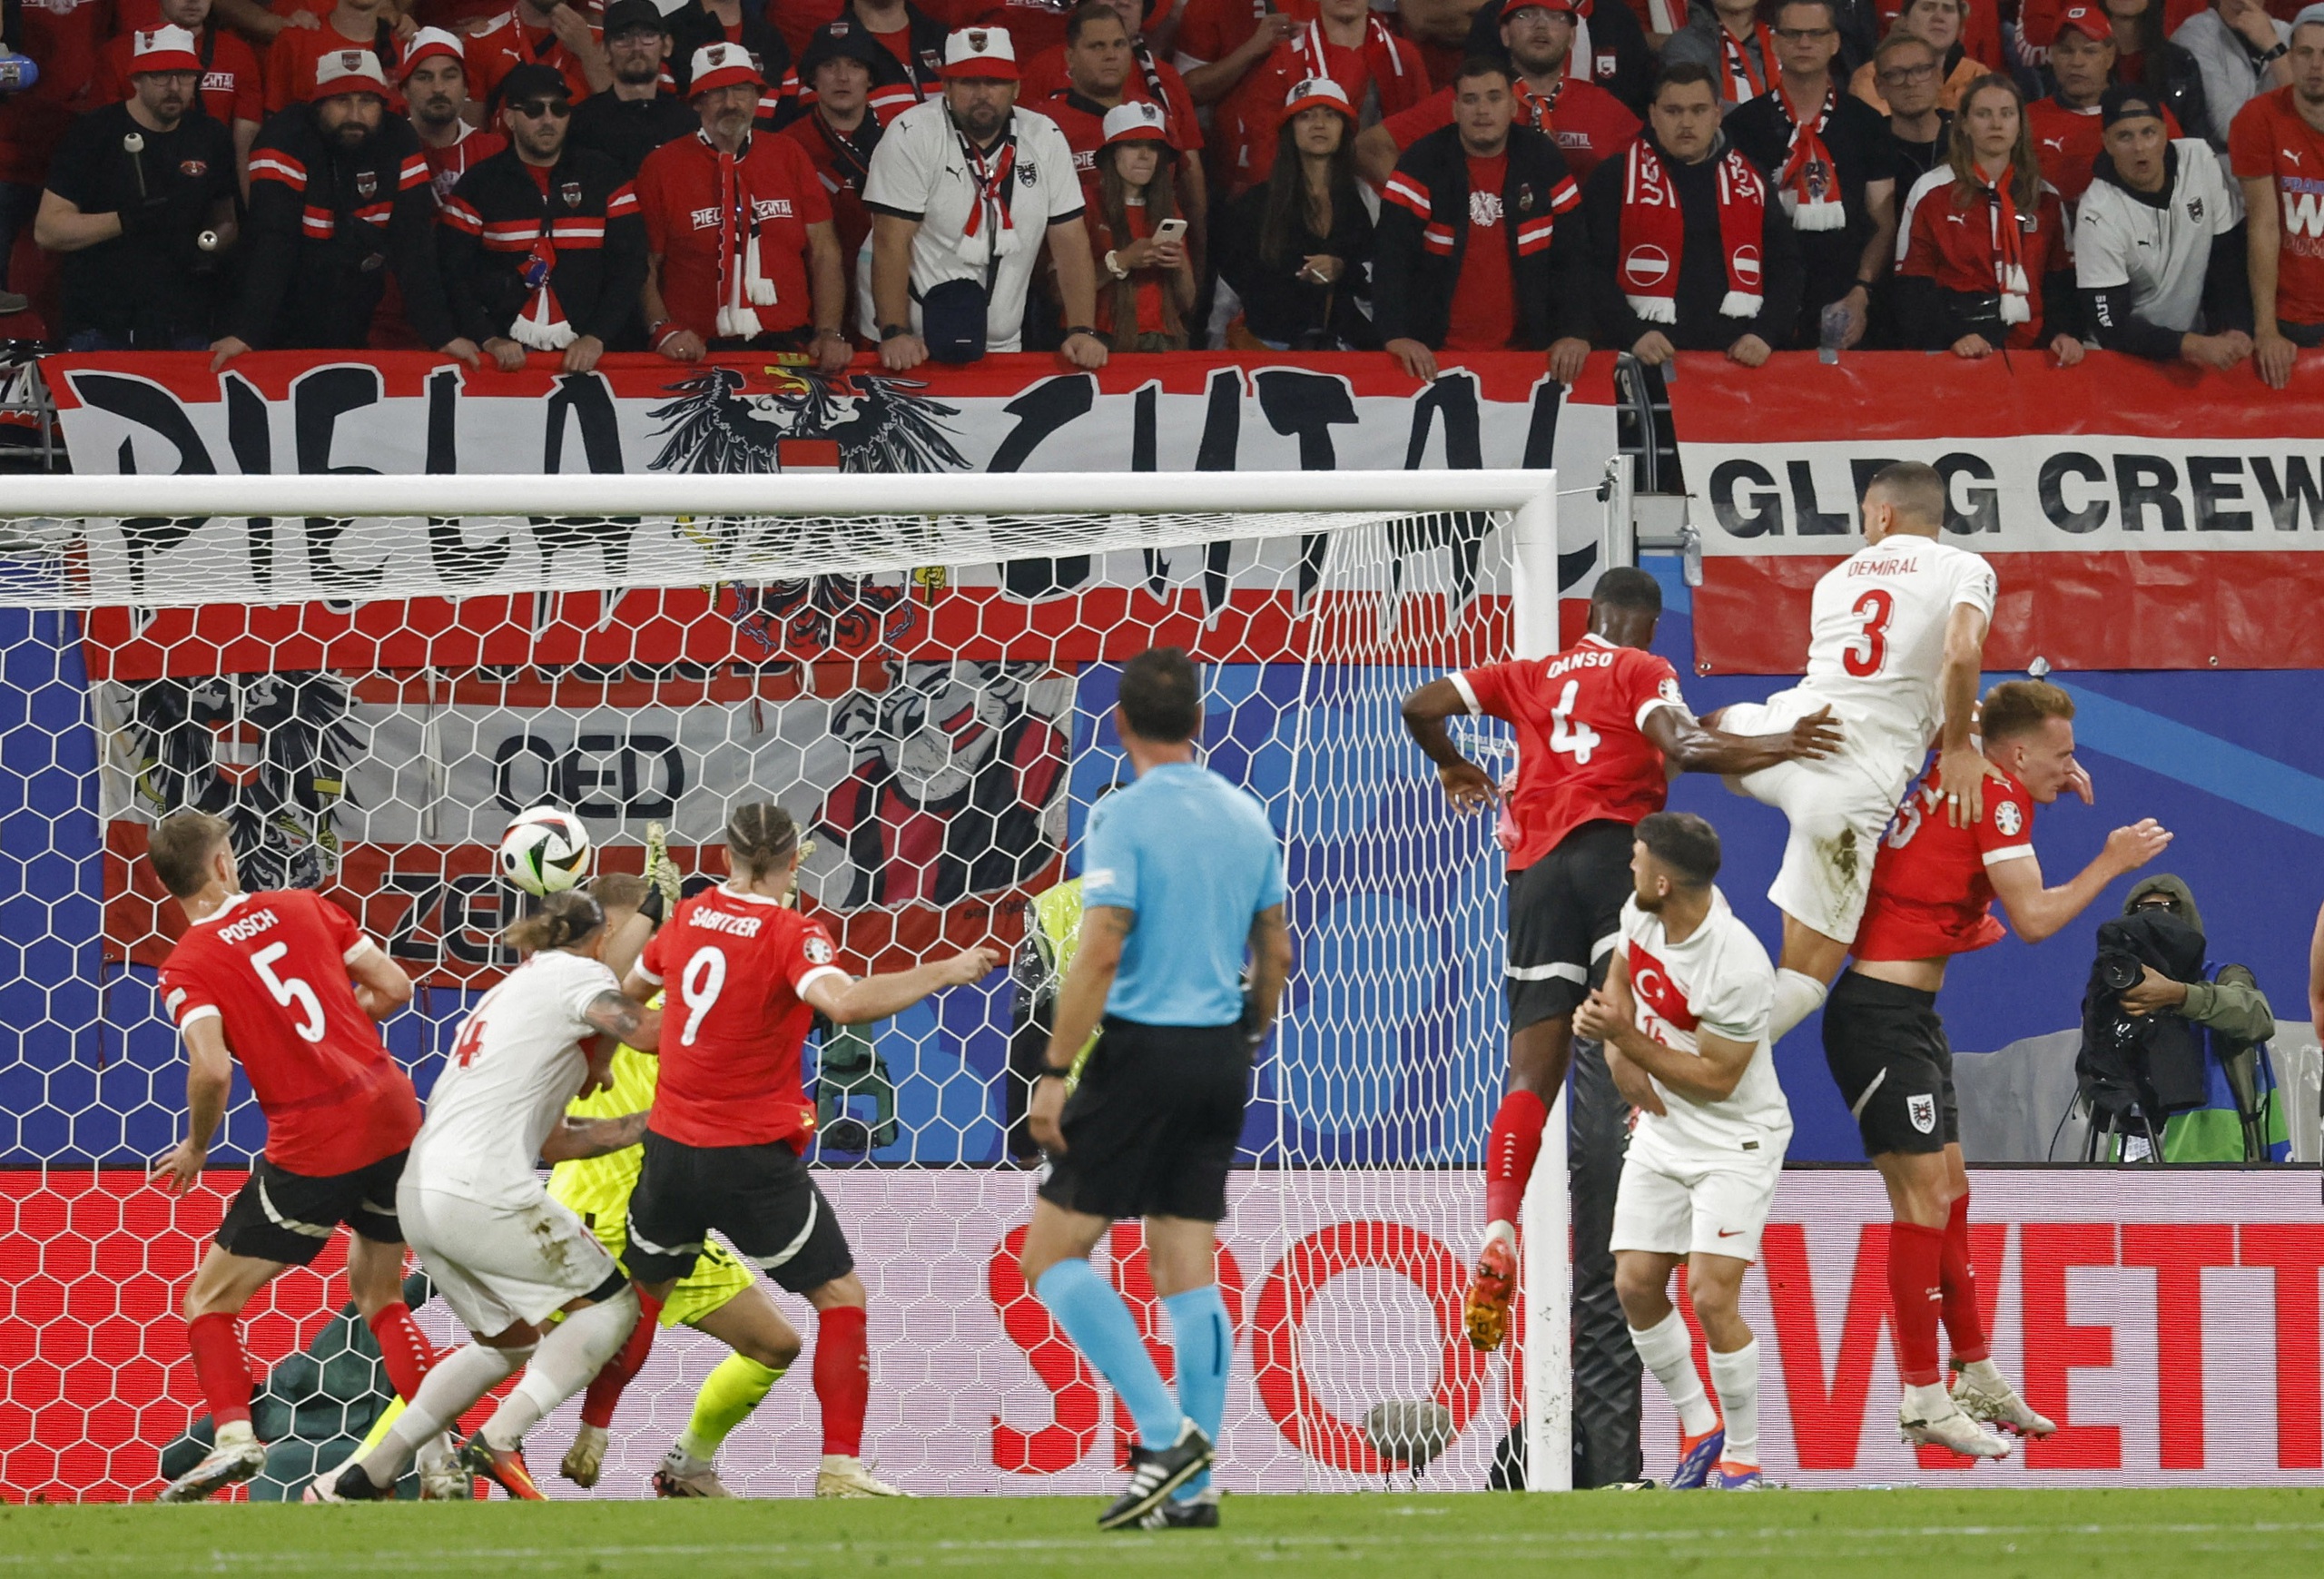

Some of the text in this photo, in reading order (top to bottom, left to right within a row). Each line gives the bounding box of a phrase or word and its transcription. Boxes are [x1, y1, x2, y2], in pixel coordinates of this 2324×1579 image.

[2038, 451, 2324, 532] CREW
[1546, 651, 1614, 679] DANSO
[1843, 588, 1895, 678] 3
[1549, 679, 1601, 765] 4
[217, 907, 280, 945] POSCH
[688, 905, 762, 939] SABITZER
[250, 940, 326, 1043] 5
[681, 945, 727, 1047] 9
